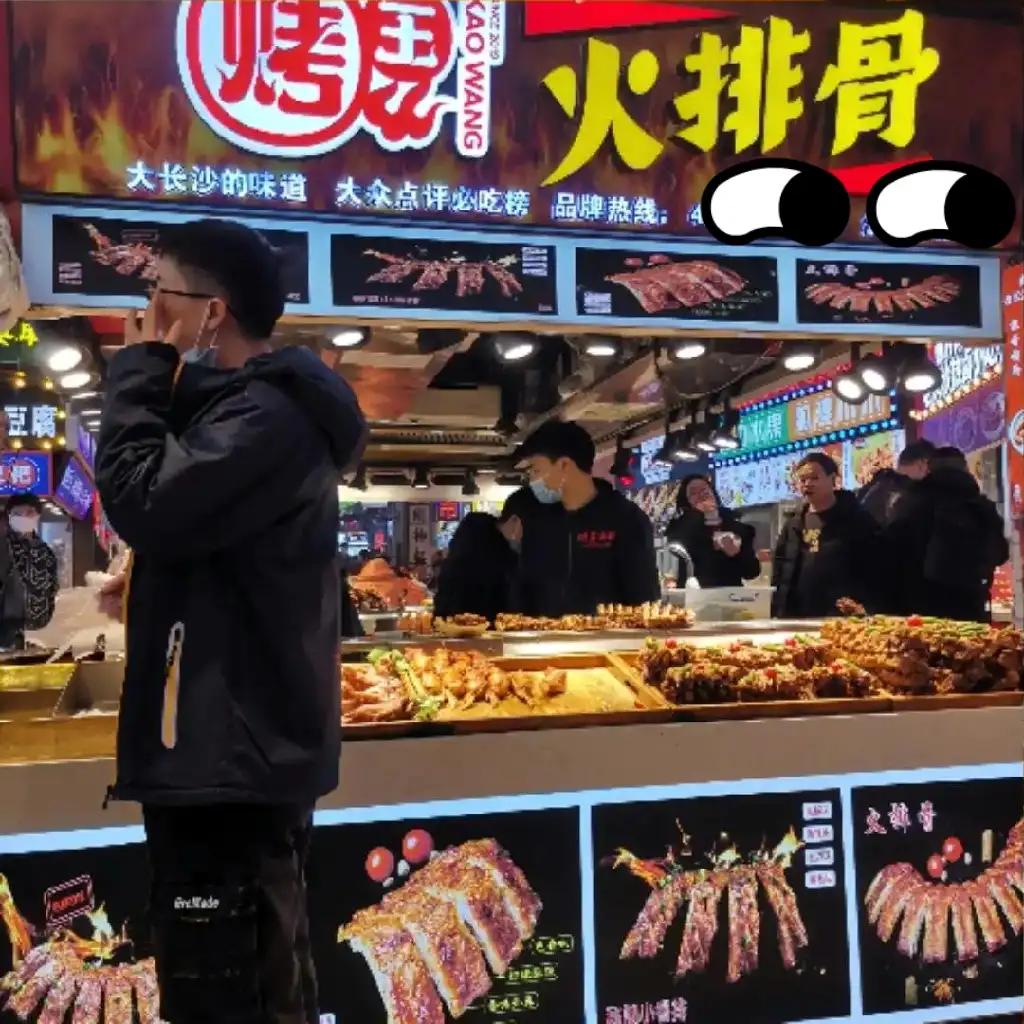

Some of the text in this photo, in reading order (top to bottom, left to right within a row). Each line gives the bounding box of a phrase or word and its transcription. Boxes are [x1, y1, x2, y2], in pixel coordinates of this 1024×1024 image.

[463, 0, 487, 150] KAO WANG
[540, 8, 941, 187] 火排骨
[126, 160, 308, 202] 大长沙的味道
[334, 175, 531, 217] 大众点评必吃榜
